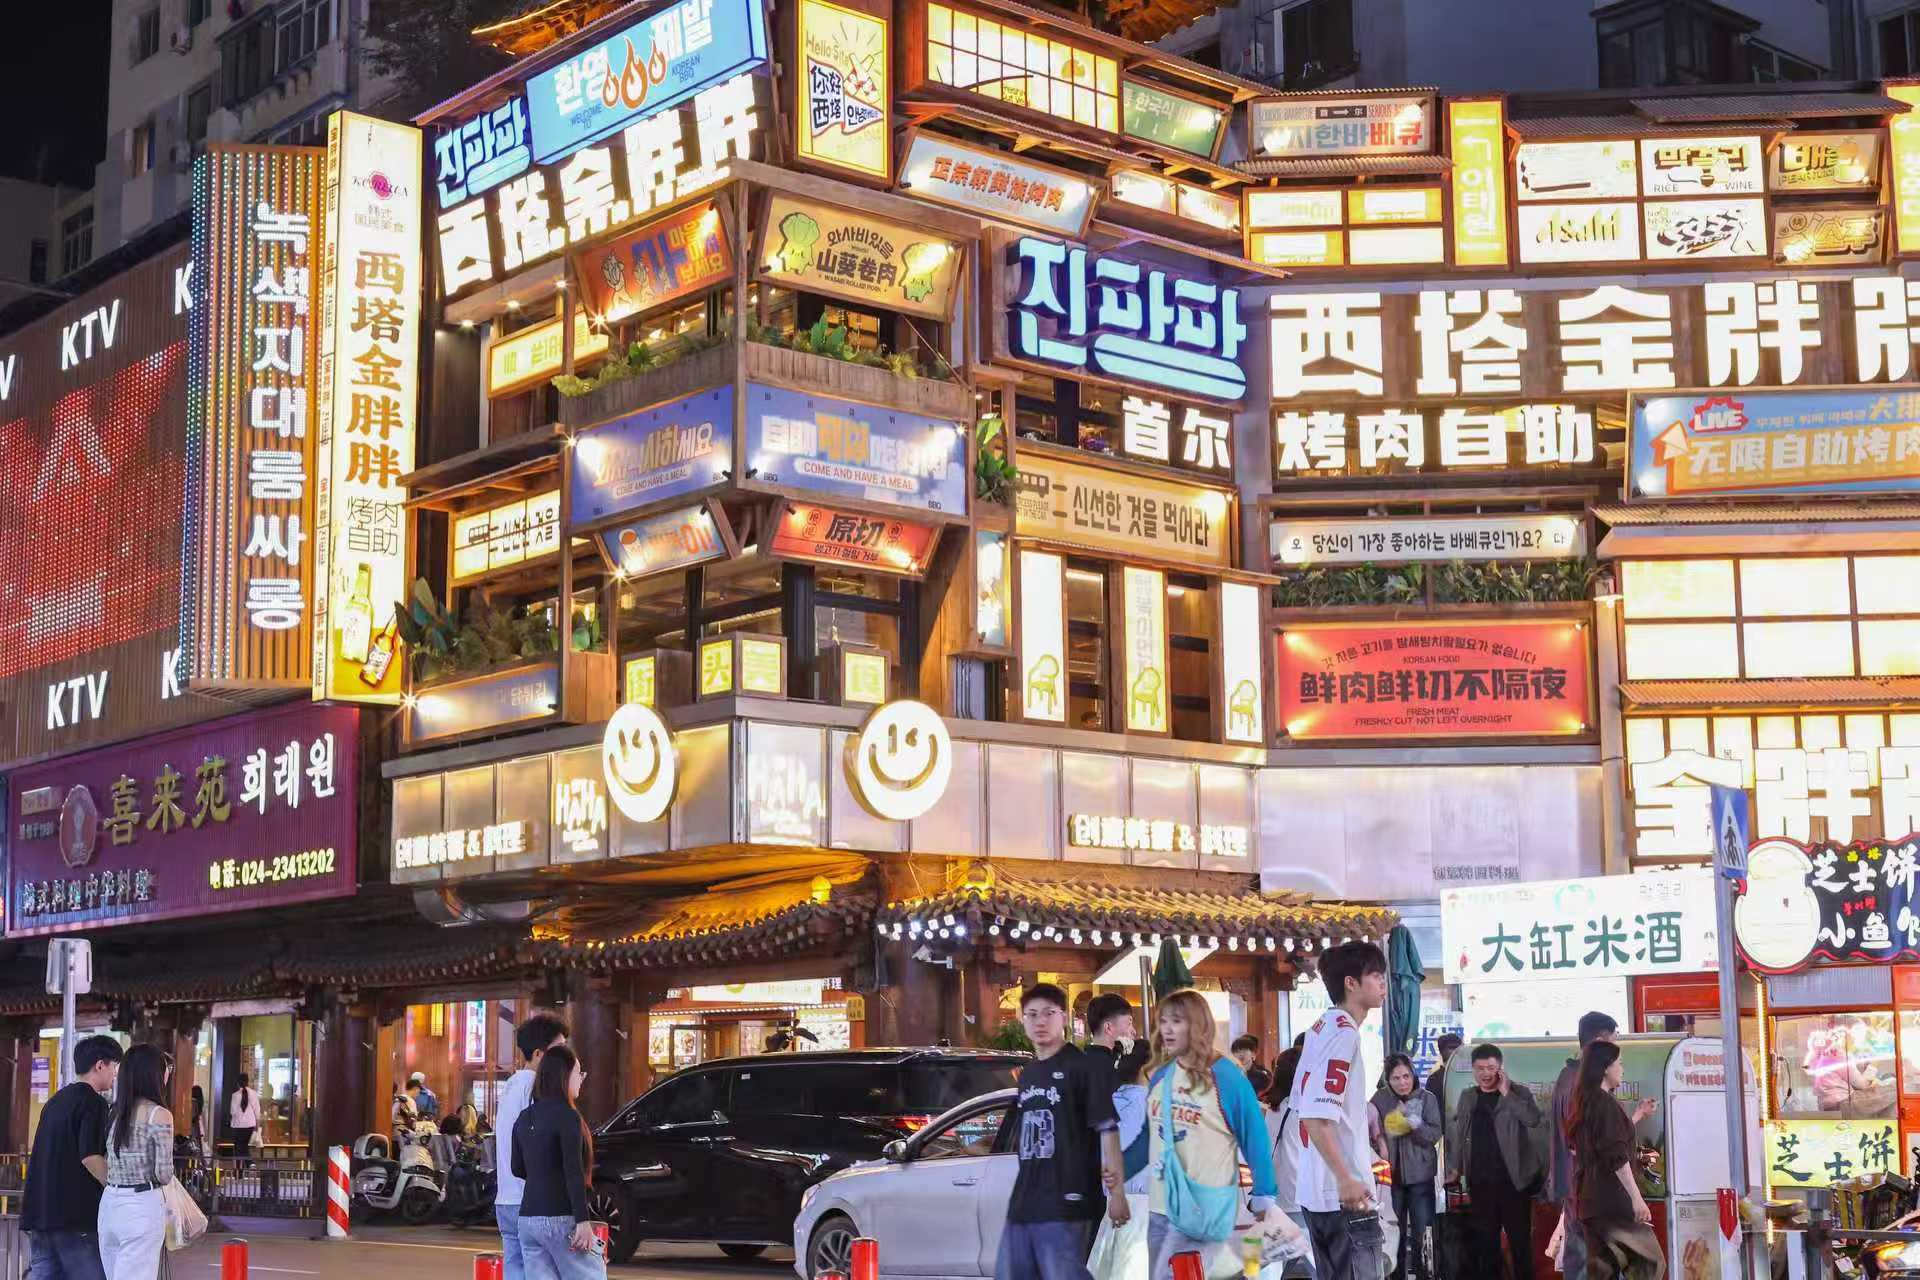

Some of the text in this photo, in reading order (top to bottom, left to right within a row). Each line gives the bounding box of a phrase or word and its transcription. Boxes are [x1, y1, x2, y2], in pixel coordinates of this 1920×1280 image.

[806, 34, 832, 57] Hello
[672, 55, 702, 76] KOREAN
[810, 65, 841, 95] 你好
[812, 98, 841, 128] 西塔
[1653, 180, 1753, 193] RICE WINE
[61, 299, 120, 371] KTV
[346, 250, 406, 488] 西塔金胖胖
[1122, 396, 1232, 469] 首尔
[1278, 403, 1594, 471] 烤肉自助
[1689, 426, 1920, 476] 无限自助烤肉
[647, 475, 664, 488] HAVE
[804, 462, 831, 476] COME
[833, 466, 853, 479] AND
[854, 470, 879, 484] HAVE
[888, 478, 913, 491] MEAL
[346, 496, 399, 528] 烤肉
[1074, 485, 1121, 533] 신선한
[1163, 501, 1210, 547] 먹어라
[348, 525, 399, 556] 自助
[825, 513, 886, 546] 原切
[1312, 528, 1543, 553] 당신이 가장 좋아하는 바베큐인가요?
[1403, 655, 1437, 665] KOREAN
[47, 671, 108, 731] KTV
[1300, 667, 1569, 704] 鲜肉鲜切不隔夜
[1355, 717, 1394, 727] FRESHLY
[1396, 716, 1414, 726] CUT
[1460, 714, 1513, 724] OVERNIGHT
[1406, 706, 1460, 717] FRESH MEAT
[241, 732, 335, 815] 희래원
[103, 755, 231, 846] 喜来苑
[1811, 842, 1920, 903] 芝士饼
[1481, 911, 1683, 974] 大缸米酒
[1324, 1058, 1352, 1095] 5
[1151, 1099, 1201, 1126] VTAGE
[1772, 1125, 1896, 1183] 芝士饼
